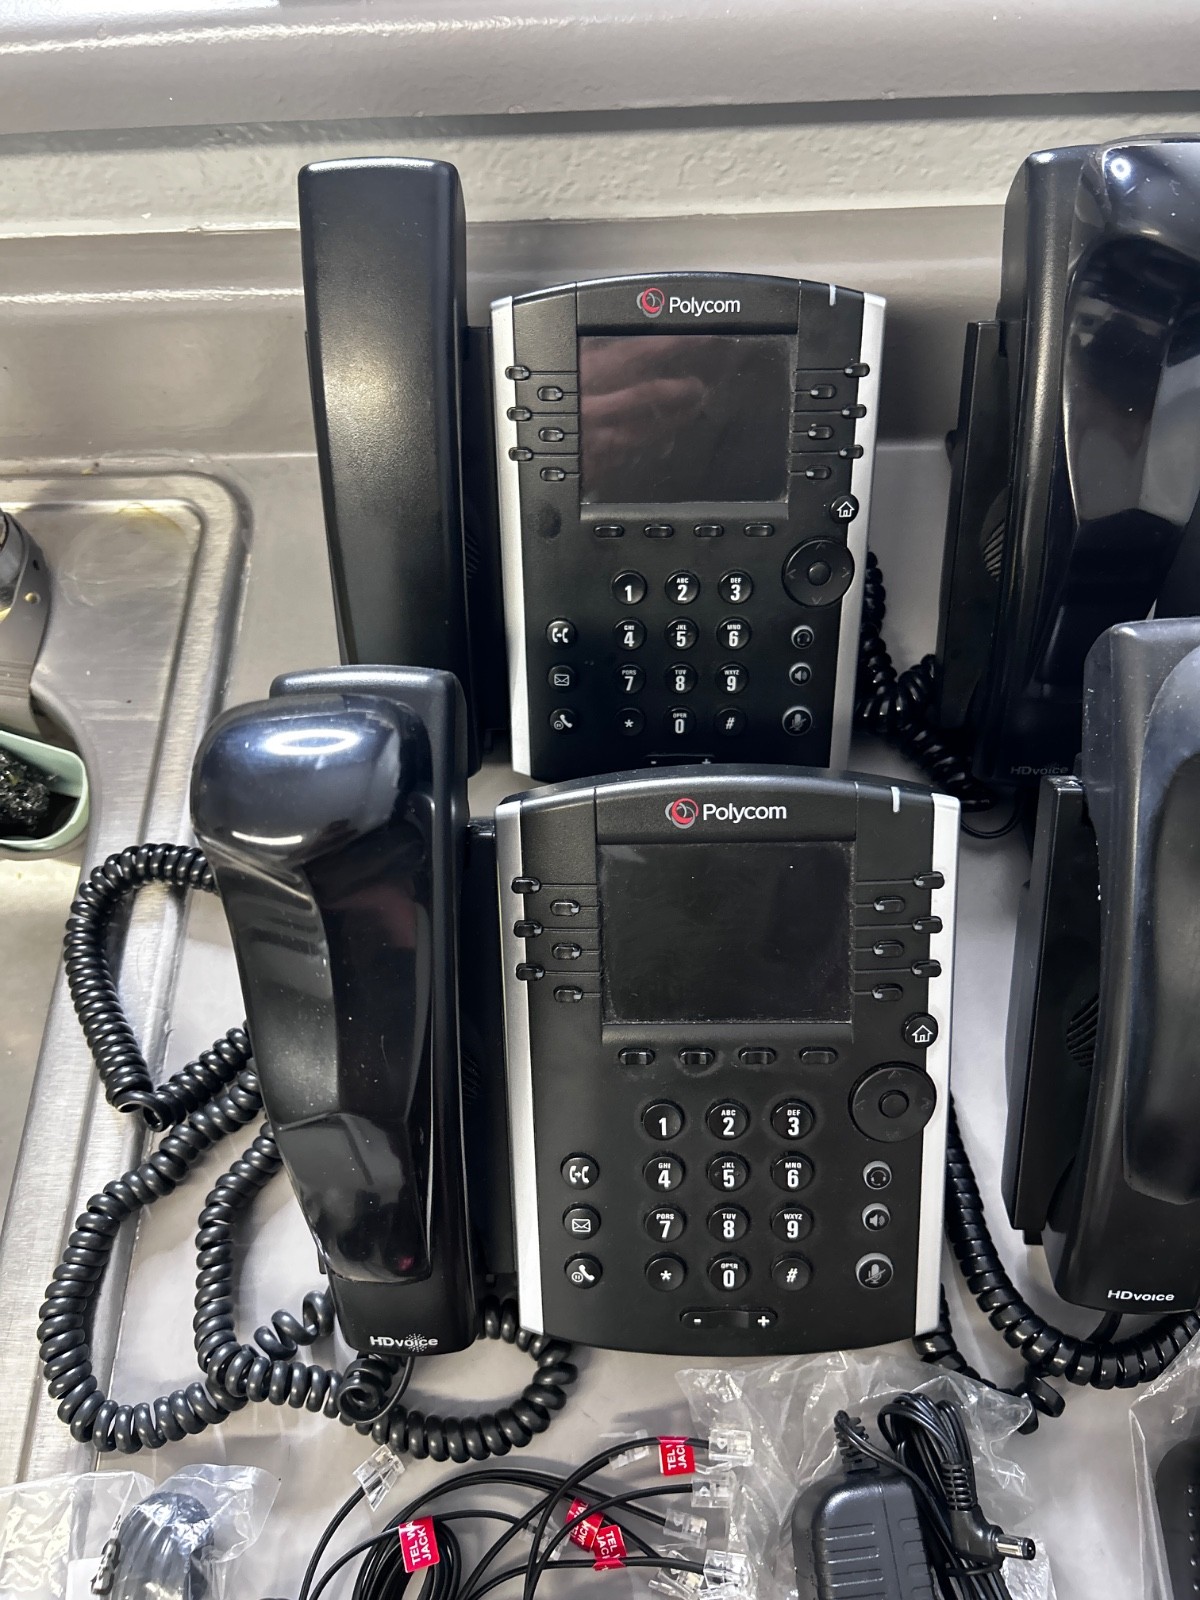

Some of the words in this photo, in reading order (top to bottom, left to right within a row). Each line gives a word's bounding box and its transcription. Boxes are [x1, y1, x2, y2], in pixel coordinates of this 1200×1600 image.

[669, 296, 741, 317] Polycom
[624, 585, 633, 601] 1
[677, 584, 687, 601] 2
[730, 584, 740, 601] 3
[623, 631, 635, 647] 4
[676, 631, 686, 647] 5
[728, 630, 738, 647] 6
[624, 676, 634, 691] 7
[675, 675, 685, 691] 8
[726, 675, 737, 691] 9
[674, 718, 685, 734] 0
[1010, 765, 1069, 775] HDvoice
[702, 803, 787, 824] Polycom
[658, 1117, 667, 1136] 1
[722, 1116, 735, 1136] 2
[787, 1116, 800, 1136] 3
[657, 1169, 671, 1189] 4
[722, 1169, 735, 1188] 5
[787, 1169, 799, 1188] 6
[659, 1220, 671, 1239] 7
[722, 1220, 735, 1239] 8
[786, 1220, 799, 1239] 9
[722, 1269, 735, 1289] 0
[1107, 1289, 1175, 1302] HDvoice
[369, 1335, 439, 1347] HDvoice
[666, 1449, 677, 1470] TEL
[417, 1526, 432, 1561] JACK
[606, 1530, 618, 1552] TEL
[409, 1540, 421, 1566] TEL
